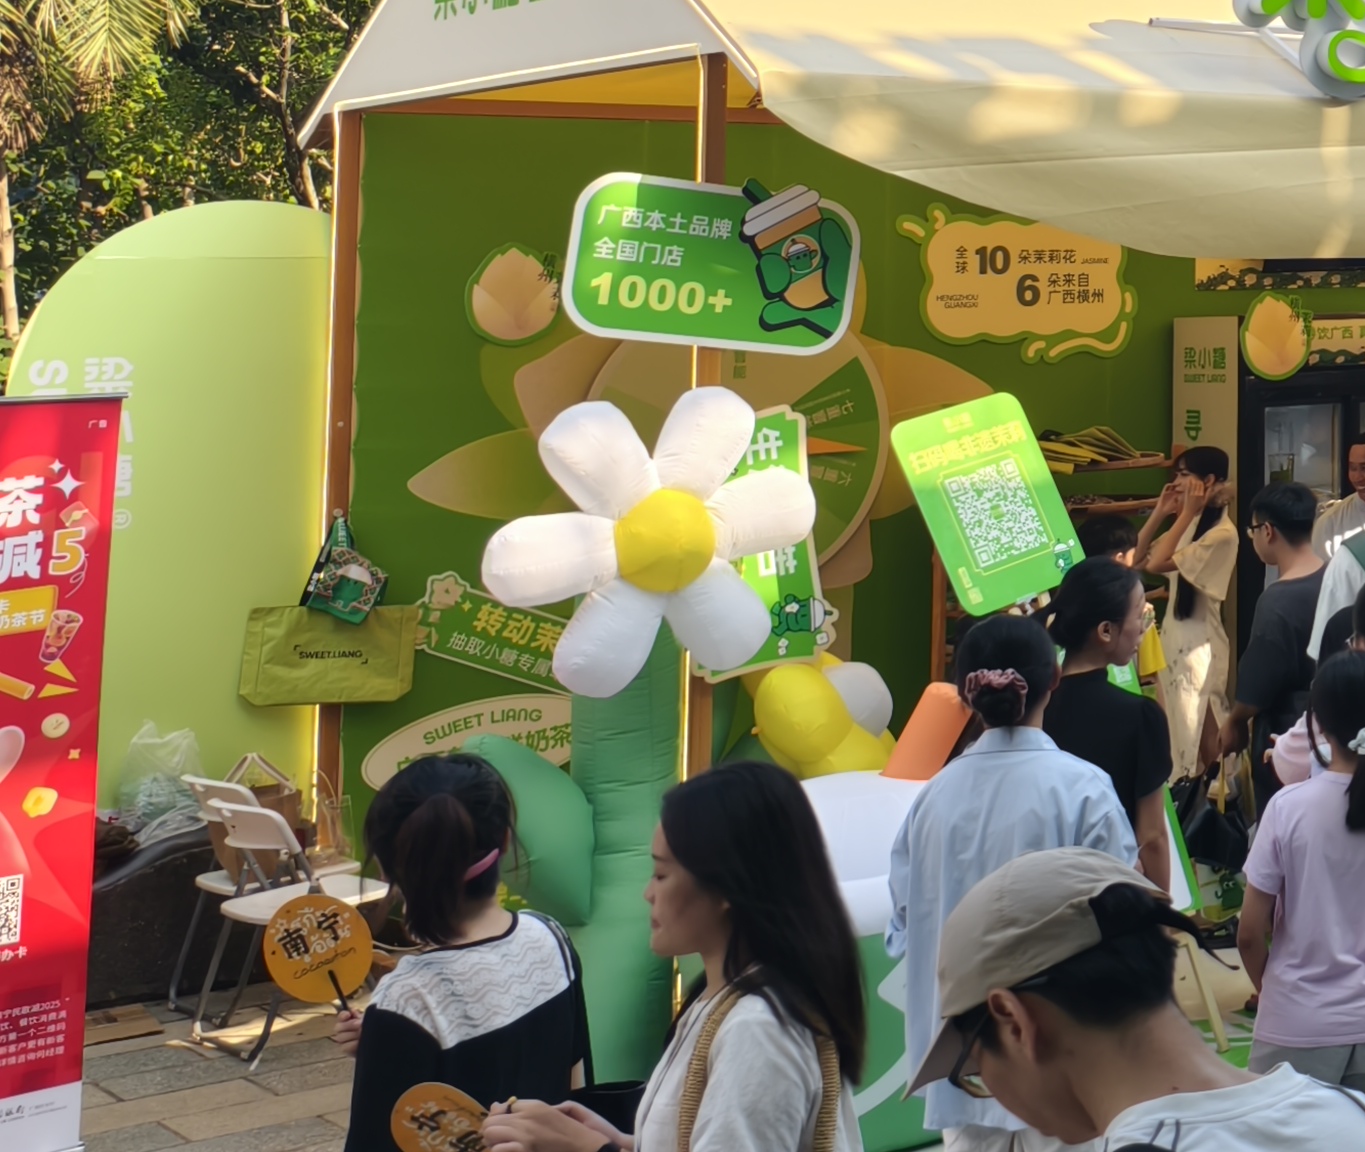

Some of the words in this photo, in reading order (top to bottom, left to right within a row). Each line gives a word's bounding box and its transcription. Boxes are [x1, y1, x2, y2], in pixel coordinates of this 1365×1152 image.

[597, 204, 733, 241] 广西本土品牌
[593, 237, 685, 268] 全国门店
[974, 244, 1011, 276] 10
[1017, 249, 1077, 265] 朵茉莉花
[590, 271, 733, 315] 1000+
[1016, 274, 1041, 307] 6
[1047, 272, 1090, 288] 朵来自
[1047, 288, 1105, 305] 广西横州
[1308, 325, 1354, 340] 饮广西
[1184, 347, 1226, 369] 梁小糖
[423, 712, 484, 745] SWEET
[490, 708, 542, 724] LIANG
